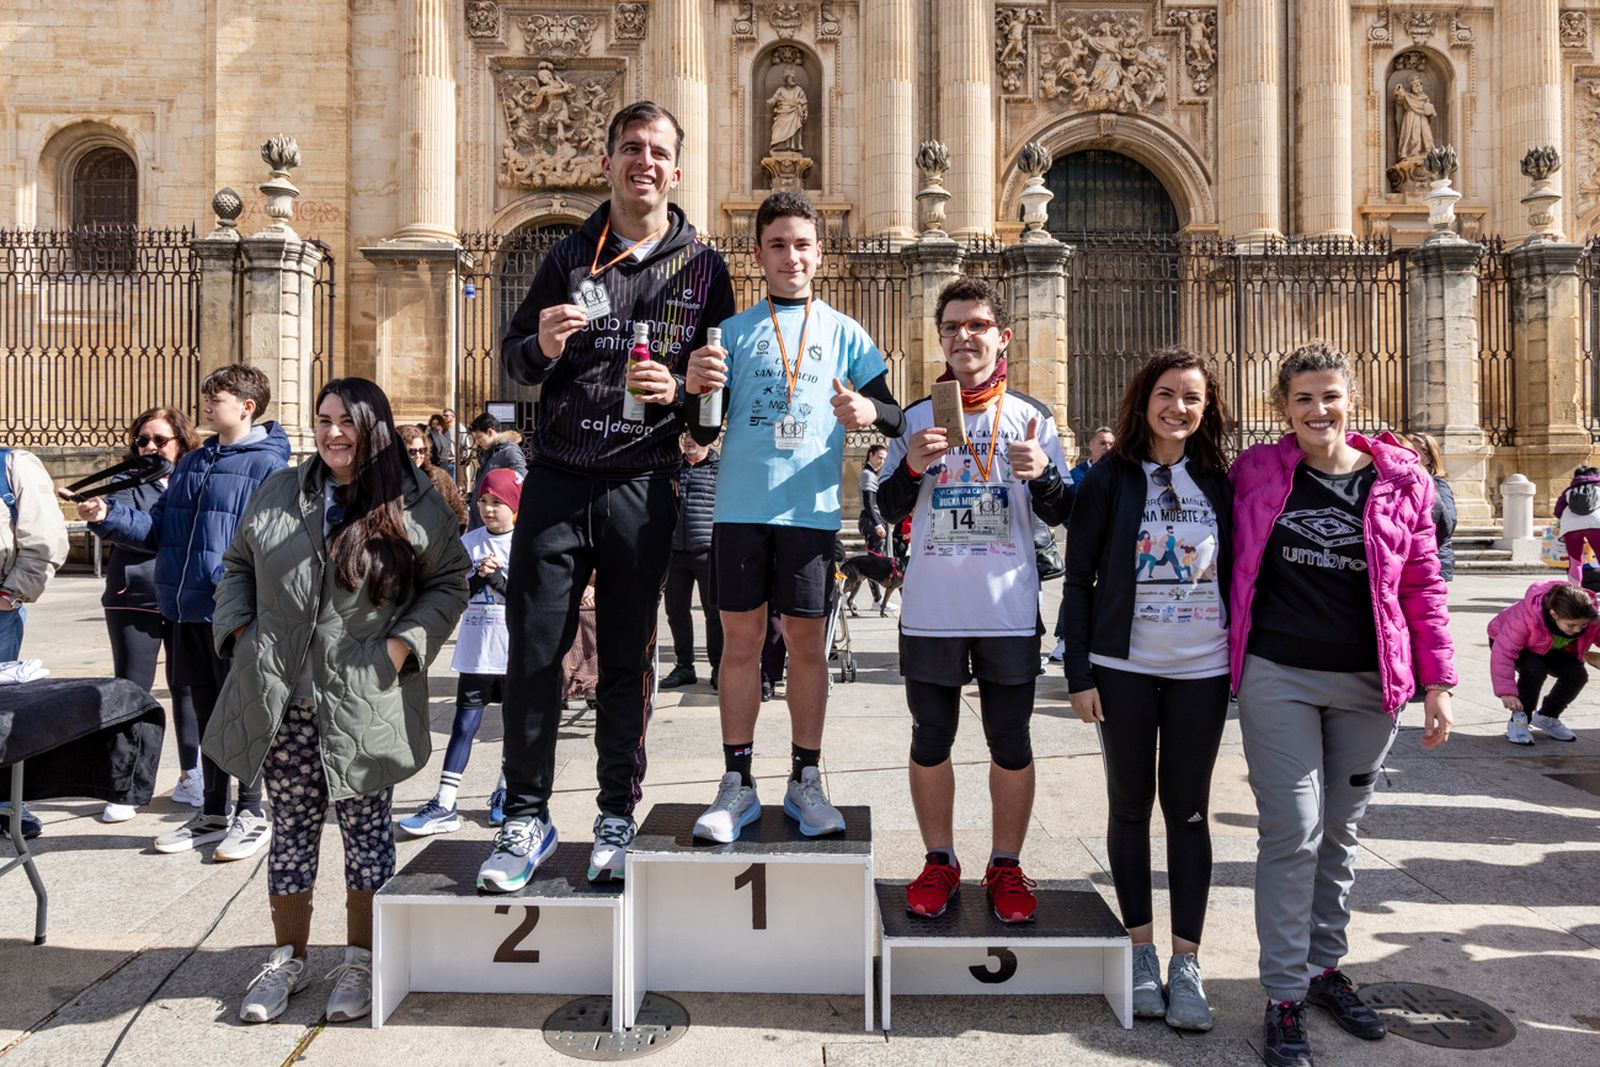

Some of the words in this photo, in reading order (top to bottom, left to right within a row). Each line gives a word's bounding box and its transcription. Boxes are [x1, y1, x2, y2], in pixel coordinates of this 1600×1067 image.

[754, 369, 773, 378] SAN
[950, 510, 975, 530] 14
[1161, 509, 1198, 522] MUERTE
[1282, 545, 1367, 572] umbro
[734, 862, 767, 930] 1
[493, 905, 540, 963] 2
